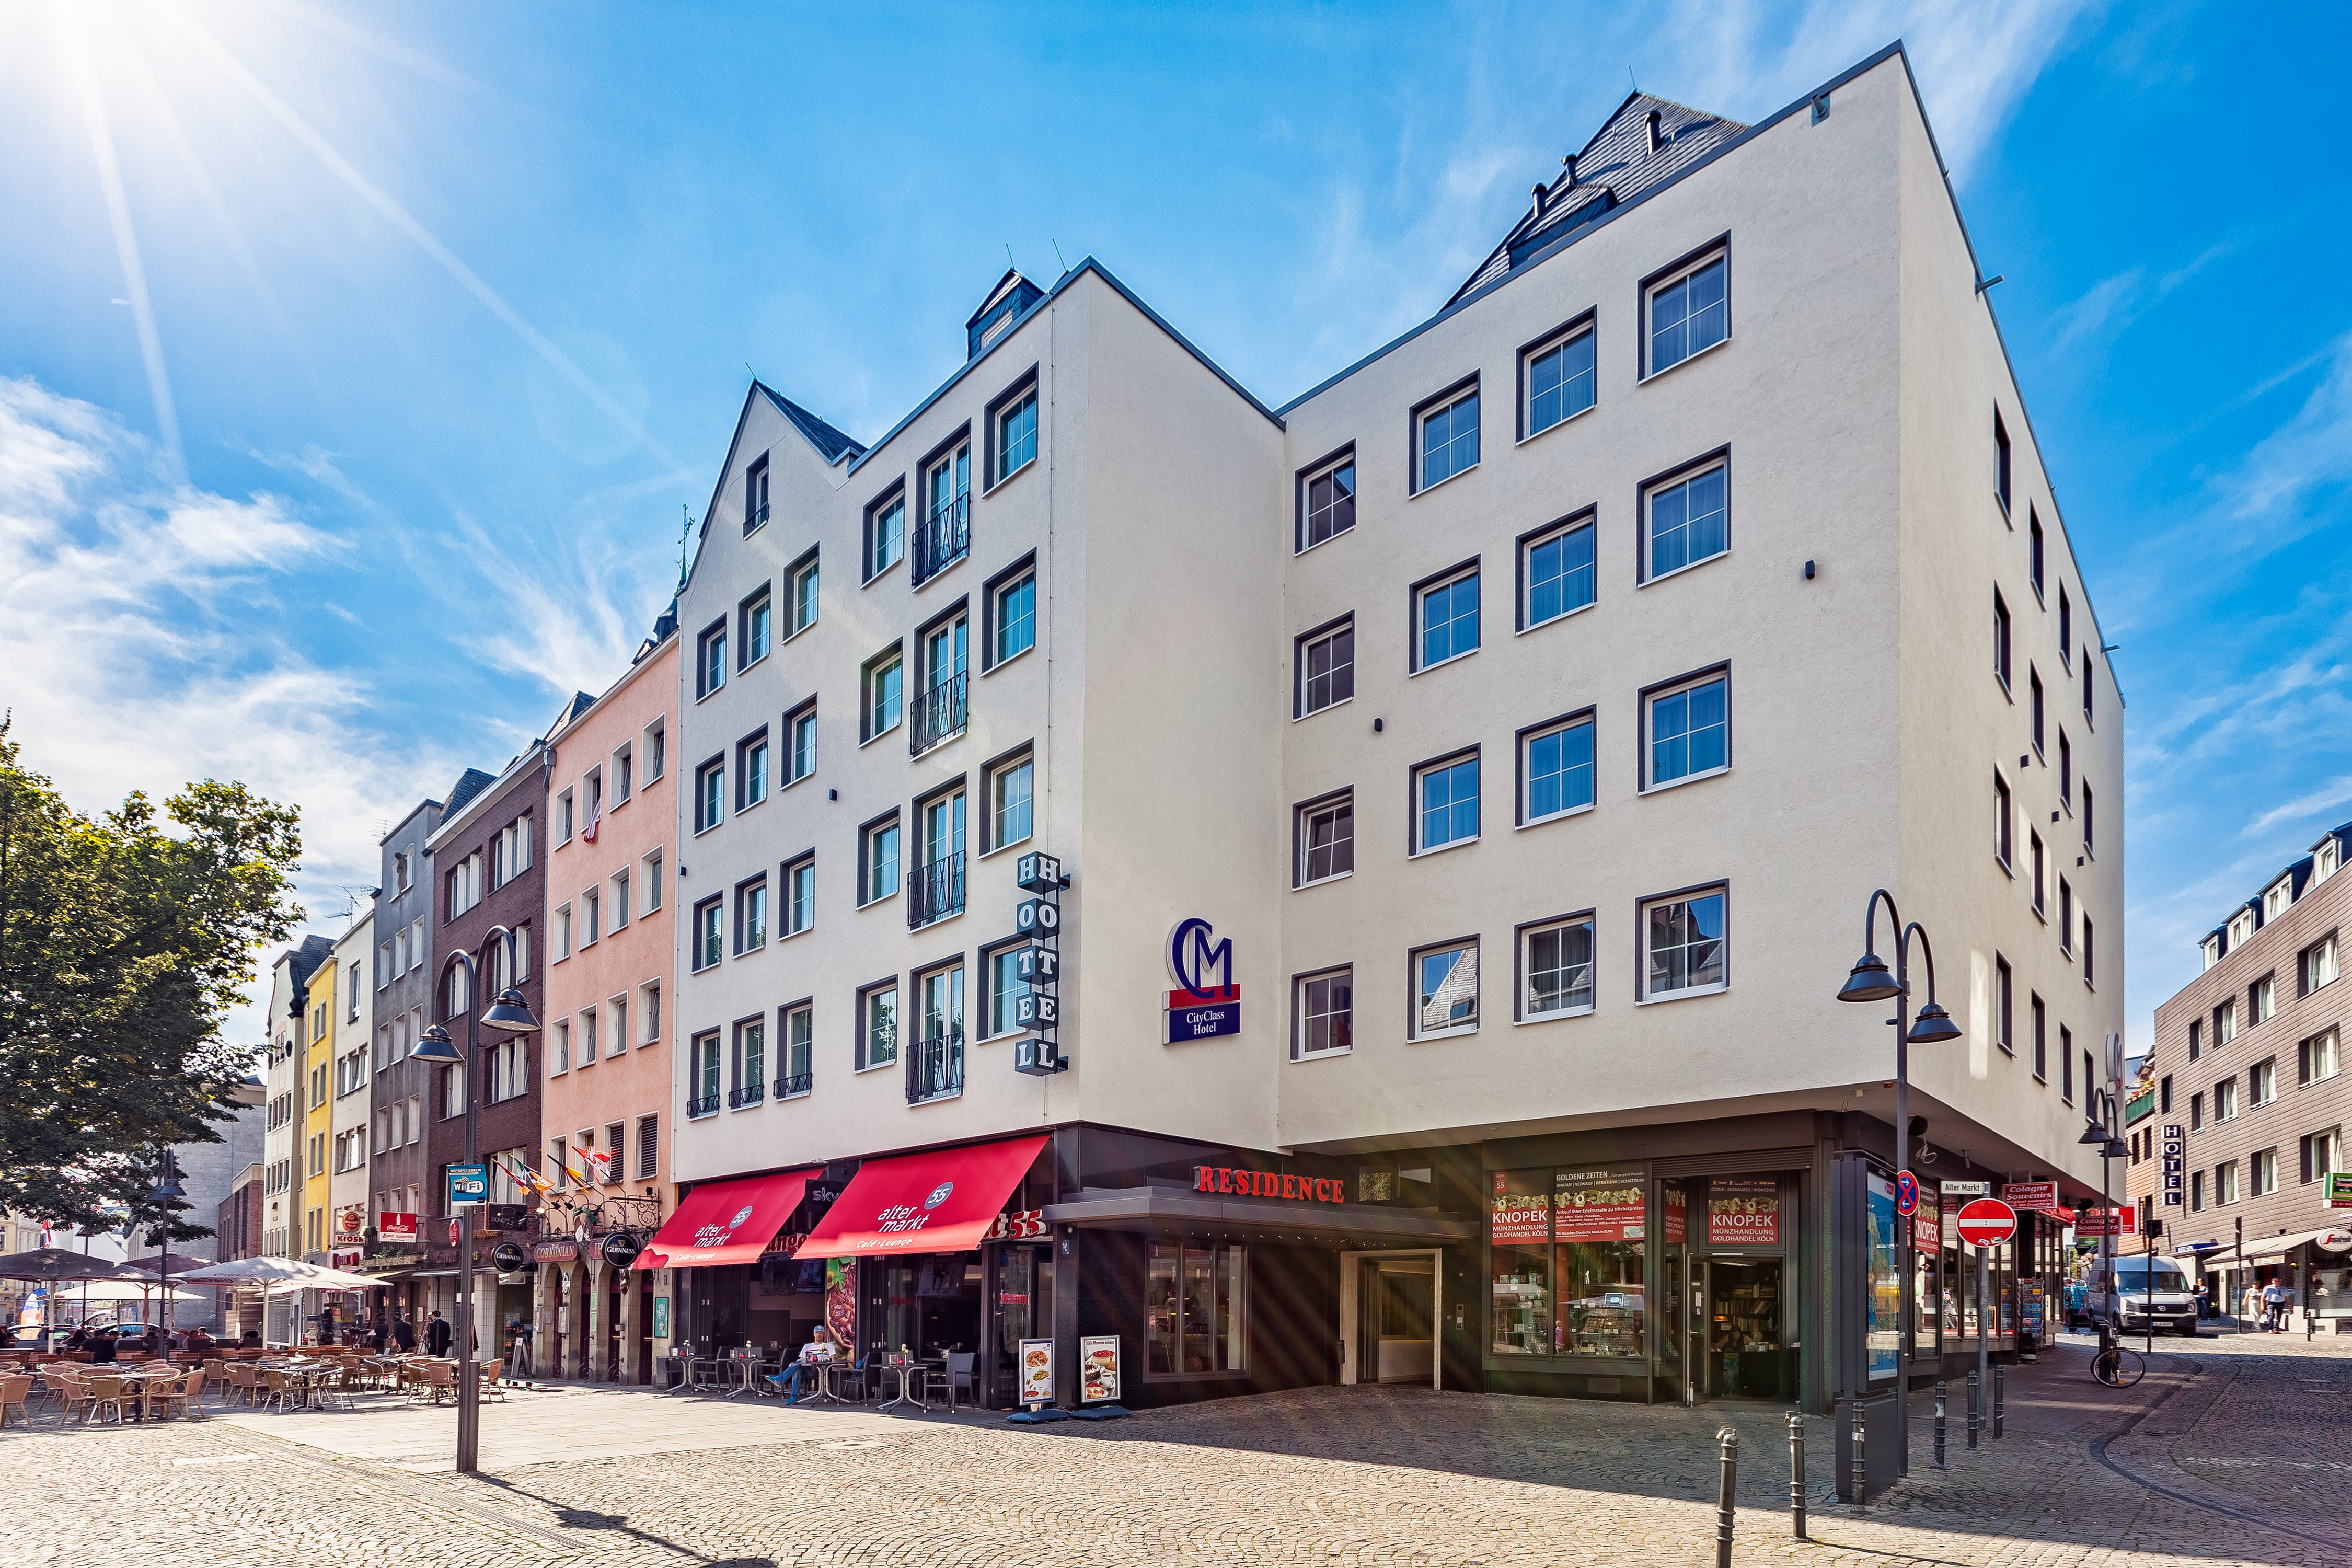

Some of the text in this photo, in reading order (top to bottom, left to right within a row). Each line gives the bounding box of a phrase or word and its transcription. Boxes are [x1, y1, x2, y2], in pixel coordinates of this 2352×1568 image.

[1018, 856, 1035, 1068] HOTEL
[1038, 856, 1058, 1069] HOTEL
[1186, 1010, 1225, 1024] CityClass
[1193, 1022, 1216, 1035] Hotel
[2165, 1126, 2179, 1204] HOTEL
[1556, 1172, 1585, 1181] GOLDENE
[1194, 1166, 1344, 1203] RESIDENCE
[813, 1187, 840, 1204] sky
[927, 1187, 950, 1204] 55
[2006, 1192, 2052, 1201] Souvenirs
[732, 1209, 750, 1224] 55
[878, 1204, 919, 1221] alter
[1493, 1210, 1548, 1224] KNOPEK
[878, 1213, 930, 1233] markt
[1009, 1209, 1044, 1239] 55
[1493, 1224, 1548, 1232] MÜNZHANDLUNG
[1712, 1214, 1773, 1227] KNOPEK
[694, 1223, 726, 1238] alter
[693, 1232, 732, 1248] markt
[856, 1238, 913, 1248] Café-Lounge
[497, 1253, 521, 1261] GUINNESS
[607, 1246, 635, 1254] GUINNESS
